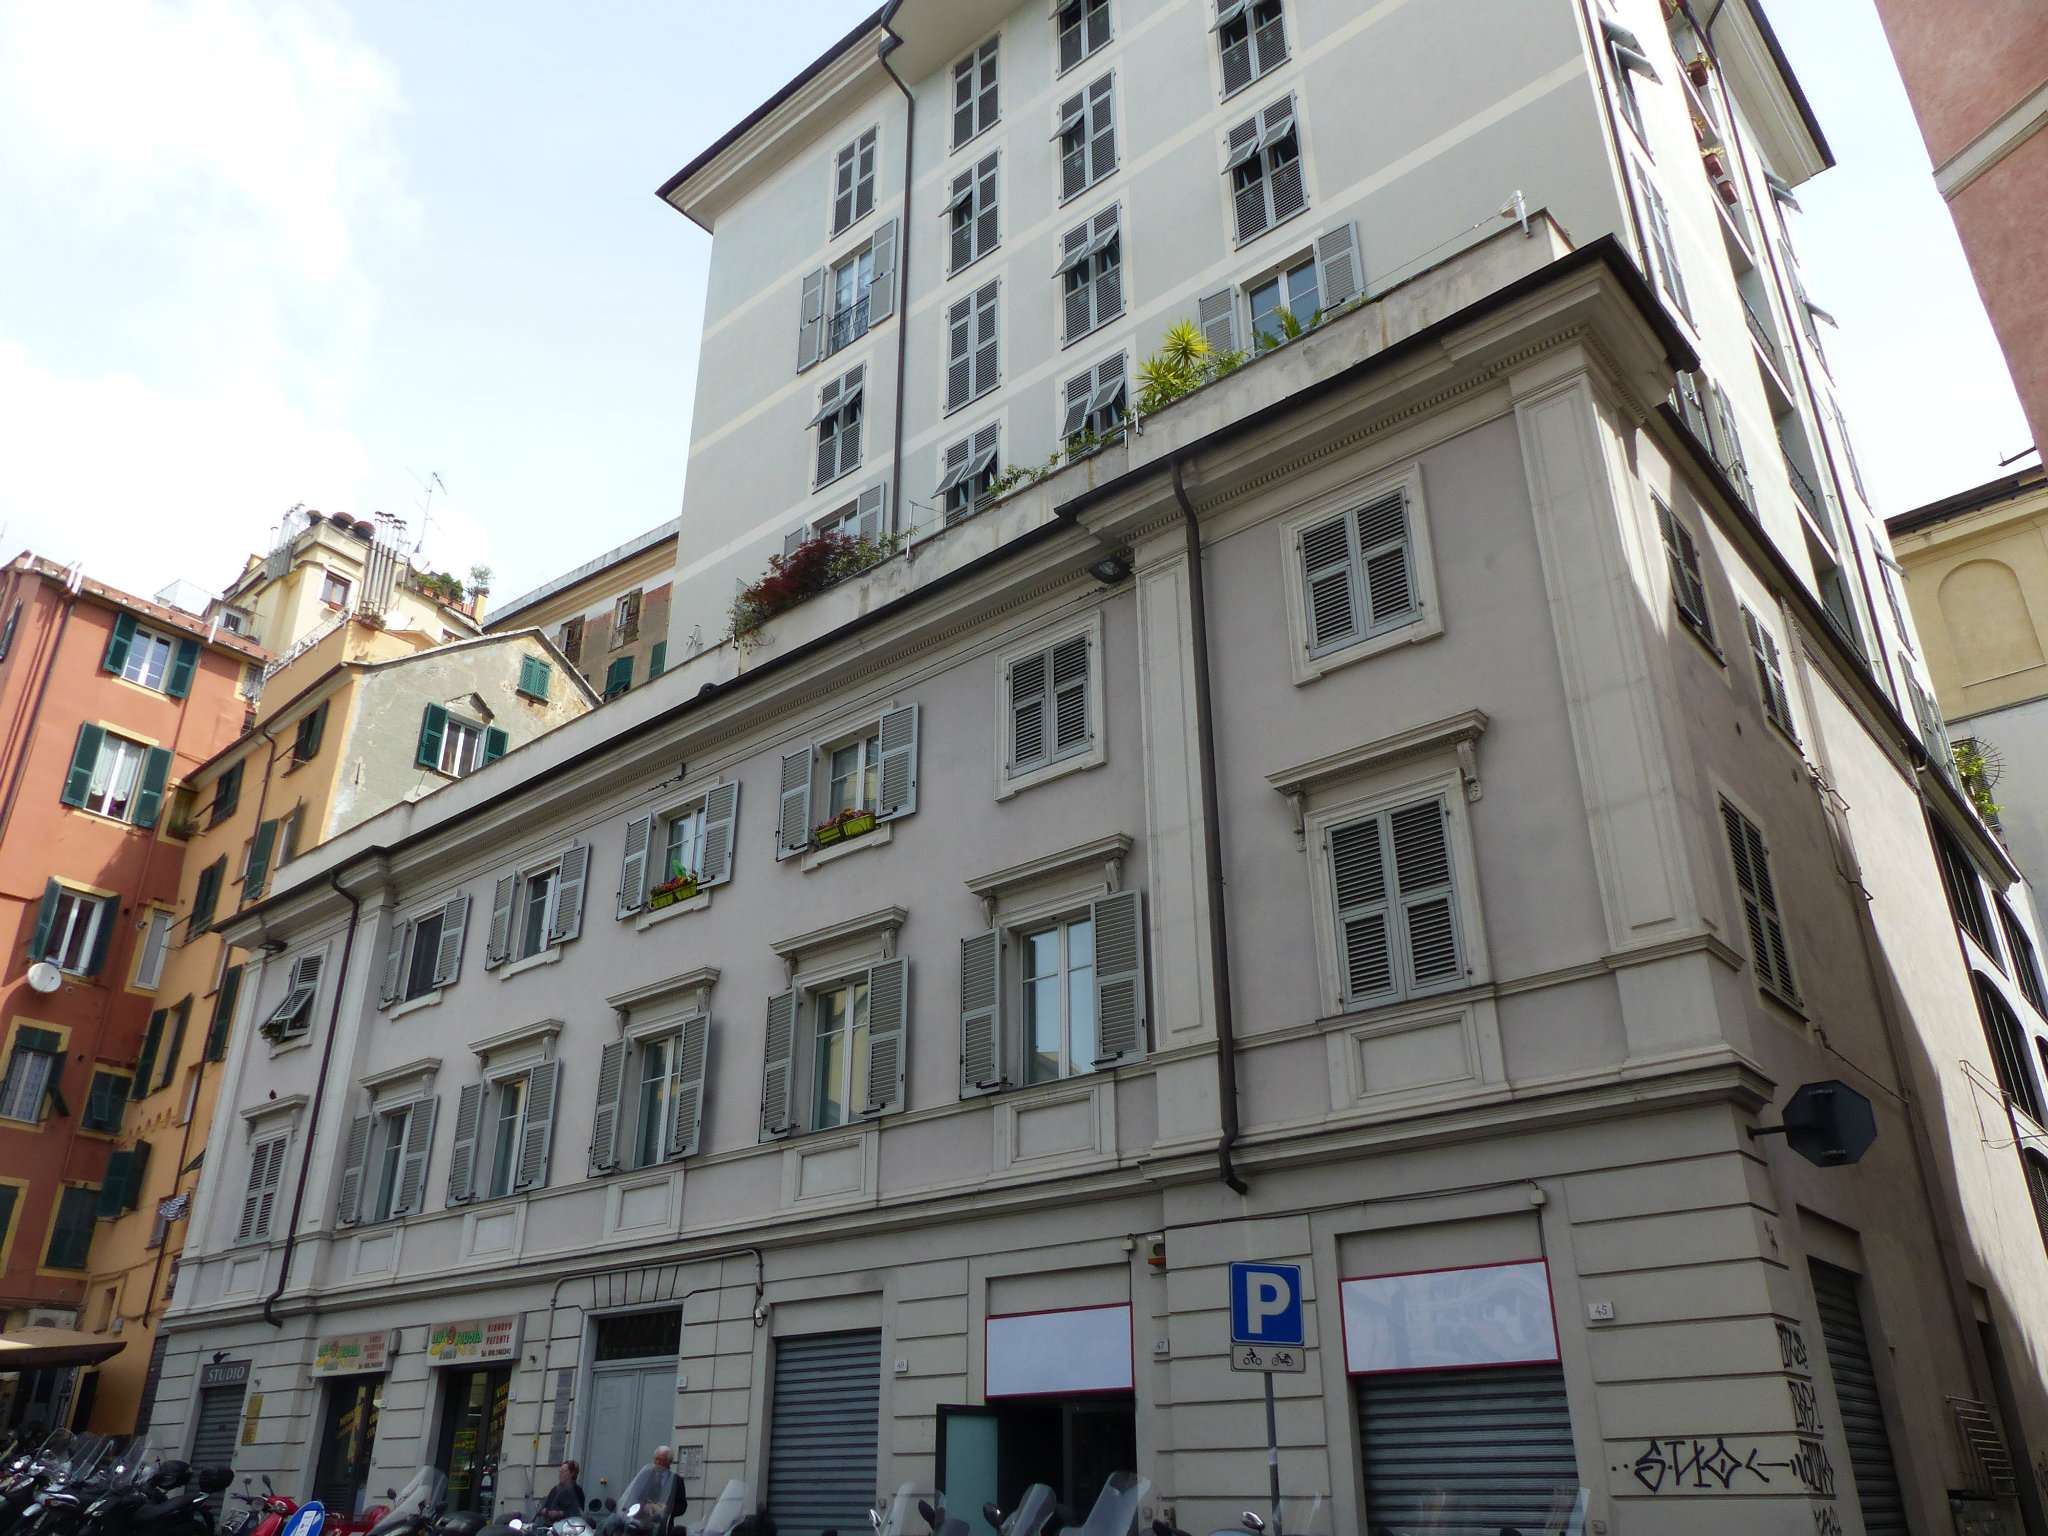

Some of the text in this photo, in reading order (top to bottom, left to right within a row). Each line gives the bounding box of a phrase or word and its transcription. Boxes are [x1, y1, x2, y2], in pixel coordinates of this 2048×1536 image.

[1246, 1271, 1291, 1335] P
[1594, 1303, 1608, 1317] 45
[208, 1366, 245, 1381] STUDIO
